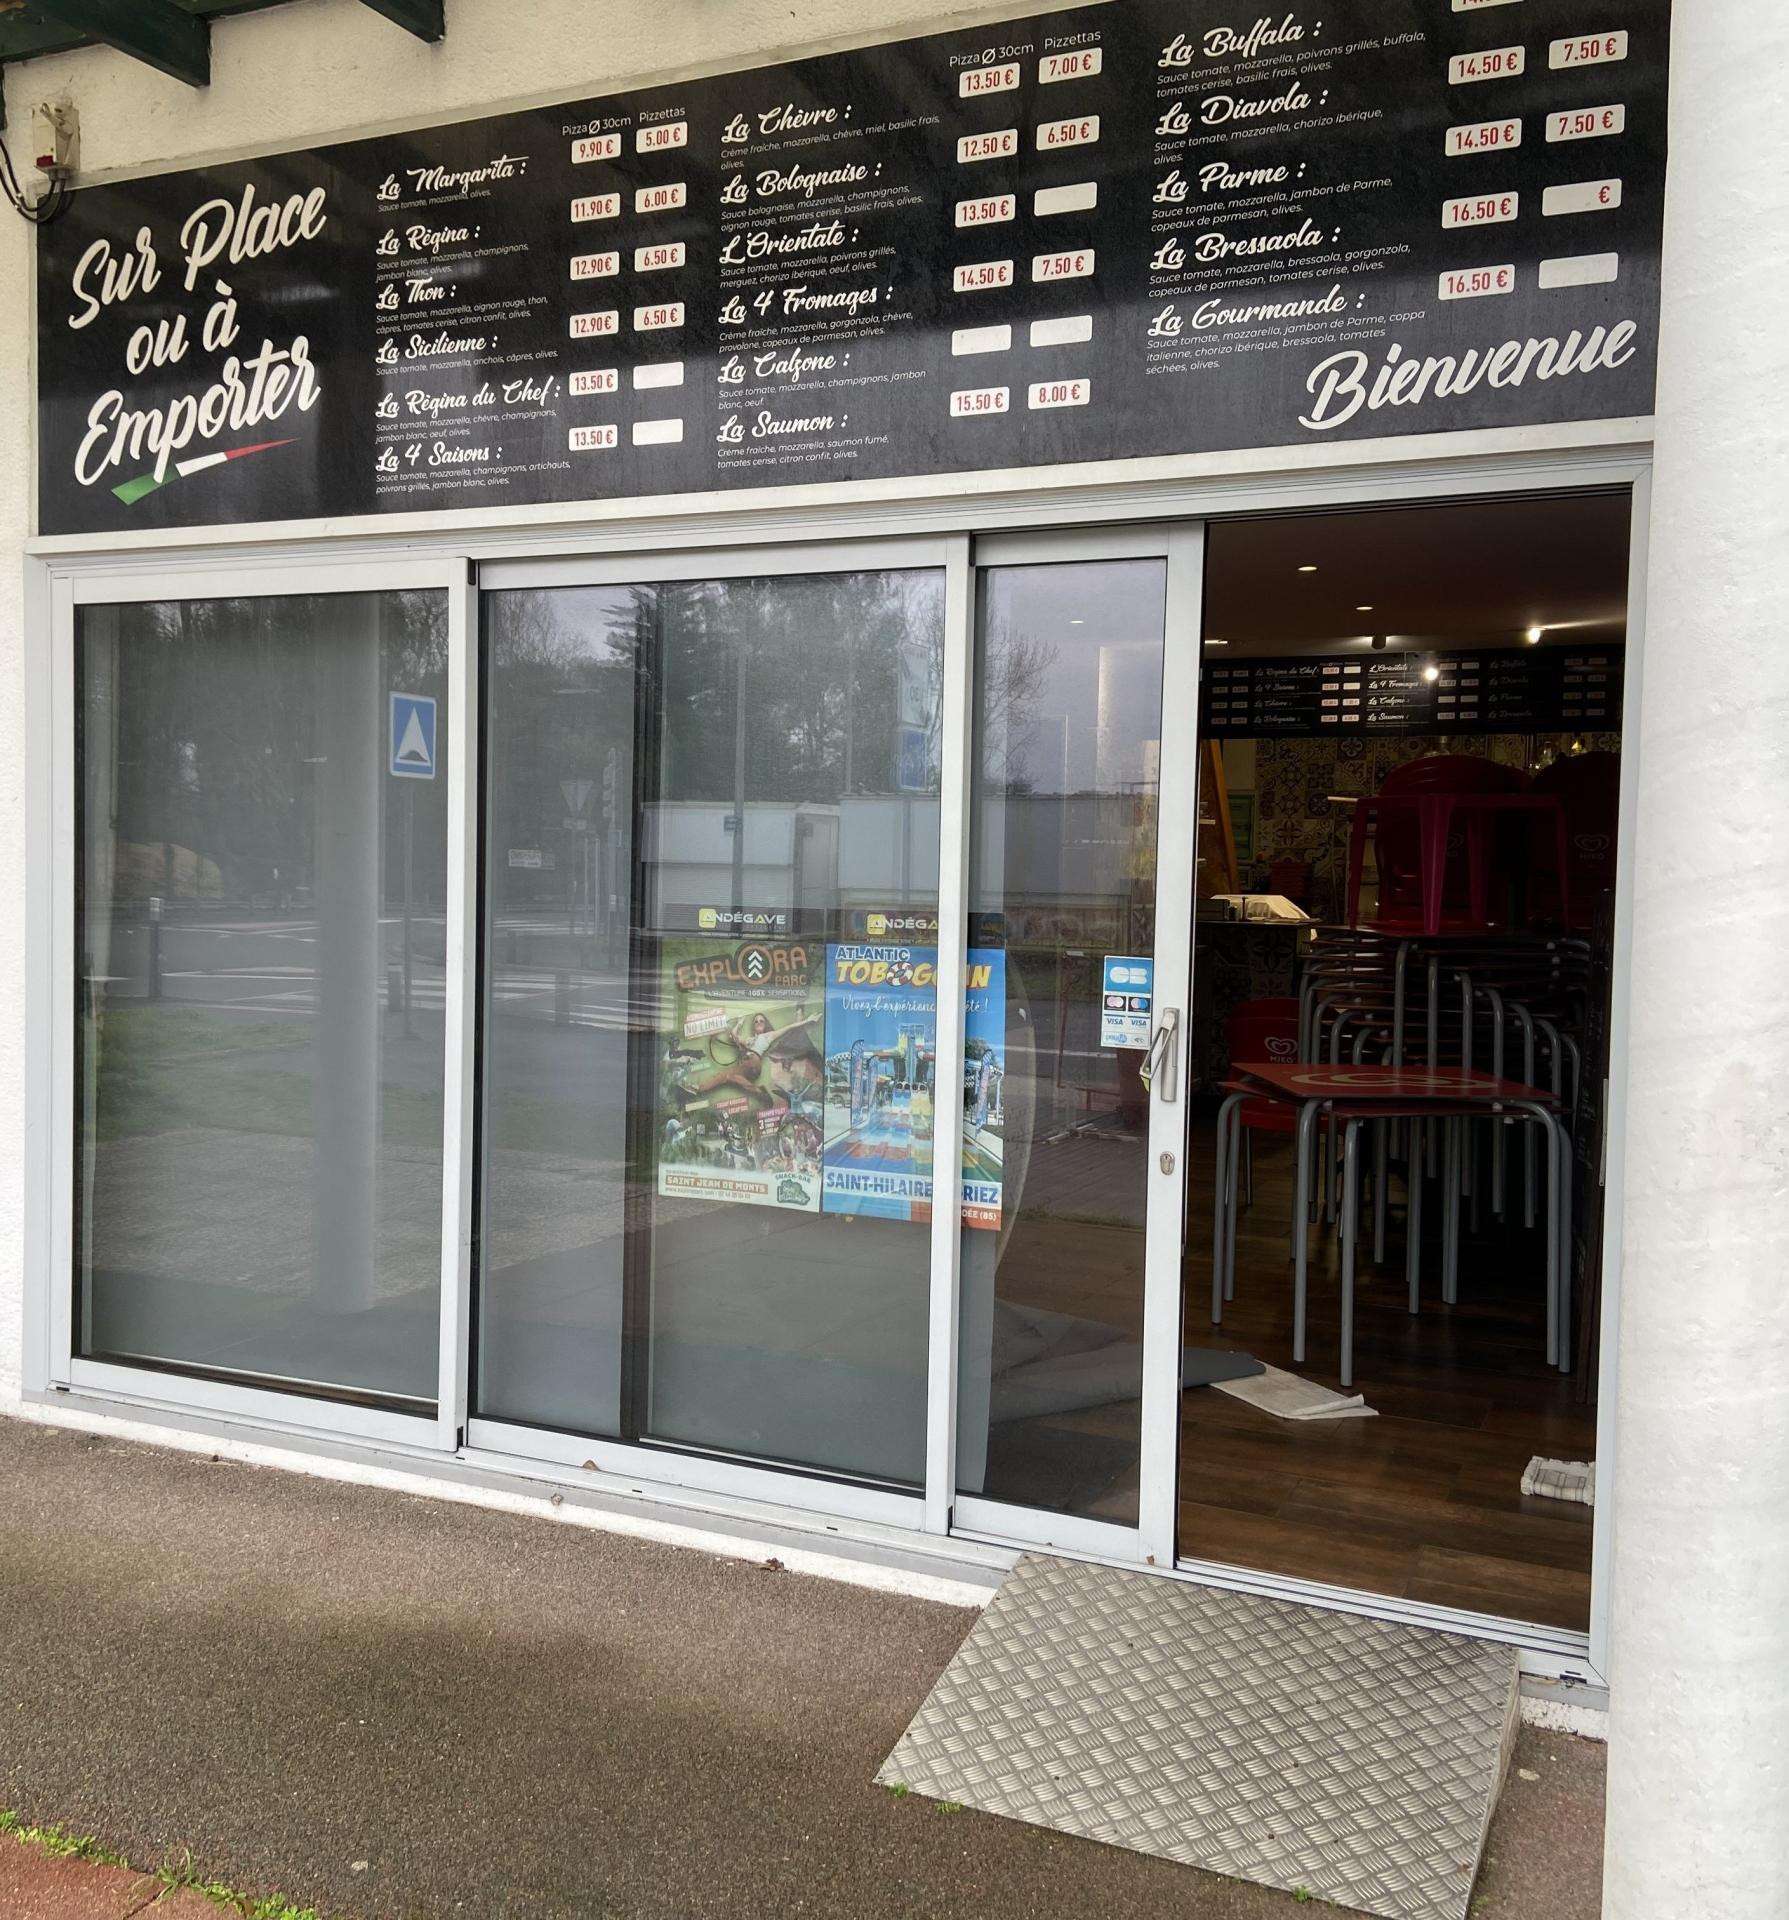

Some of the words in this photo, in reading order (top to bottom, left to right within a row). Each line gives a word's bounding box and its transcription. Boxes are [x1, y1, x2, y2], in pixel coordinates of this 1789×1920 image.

[949, 53, 980, 67] Pizza
[999, 43, 1034, 59] 30cm
[1044, 31, 1101, 50] Pizzettas
[1157, 33, 1195, 68] La
[1203, 13, 1305, 58] Buffala
[1563, 40, 1600, 62] 7.50
[1049, 56, 1078, 77] 7.00
[1458, 54, 1501, 77] 14.50
[966, 71, 1000, 91] 13.50
[1155, 101, 1192, 135] La
[1200, 81, 1311, 125] Diavola
[562, 124, 588, 136] Pizza
[602, 116, 632, 130] 30cm
[639, 107, 686, 122] Pizzettas
[721, 113, 750, 143] La
[758, 103, 839, 135] Chèvre
[1559, 113, 1595, 136] 7.50
[645, 129, 669, 147] 5.00
[1048, 124, 1076, 144] 6.50
[1455, 126, 1498, 150] 14.50
[579, 141, 602, 158] 9.90
[963, 137, 998, 157] 12.50
[377, 173, 401, 200] La
[406, 154, 530, 194] Margarita
[720, 174, 749, 204] La
[756, 163, 868, 199] Bolognaise
[1152, 169, 1189, 202] La
[1199, 162, 1290, 193] Parme
[644, 190, 668, 208] 6.00
[962, 203, 996, 223] 13.50
[1452, 200, 1496, 223] 16.50
[376, 228, 401, 256] La
[1150, 237, 1186, 270] La
[1194, 218, 1323, 262] Bressaola
[69, 226, 161, 330] Sur
[179, 183, 327, 290] Place
[644, 250, 667, 267] 6.50
[1042, 257, 1071, 276] 7.50
[960, 267, 994, 287] 14.50
[1447, 272, 1491, 295] 16.50
[375, 284, 401, 310] La
[405, 277, 446, 303] Thon
[718, 295, 747, 324] La
[753, 289, 775, 316] 4
[783, 285, 878, 315] Fromages
[643, 309, 667, 326] 6.50
[1147, 304, 1184, 337] La
[1191, 283, 1348, 330] Gourmande
[126, 314, 190, 375] ou
[202, 279, 240, 353] à
[1147, 338, 1178, 350] Sauce
[1283, 319, 1327, 336] jambon
[1330, 317, 1345, 329] de
[1389, 310, 1426, 325] coppa
[375, 338, 400, 364] La
[404, 331, 487, 360] Sicilienne
[800, 334, 810, 344] de
[1194, 343, 1233, 357] chorizo
[1339, 327, 1386, 341] tomates
[717, 355, 746, 384] La
[753, 347, 837, 382] Calzone
[1298, 319, 1637, 430] Bienvenue
[575, 374, 603, 391] 13.50
[1039, 385, 1067, 403] 8.00
[74, 336, 321, 486] Emporter
[375, 392, 400, 418] La
[472, 382, 497, 407] du
[956, 394, 991, 412] 15.50
[716, 414, 745, 443] La
[751, 410, 836, 438] Saumon
[575, 430, 603, 447] 13.50
[375, 446, 400, 472] La
[405, 442, 422, 466] 4
[428, 441, 490, 466] Saisons
[835, 945, 911, 962] ATLANTIC
[677, 943, 808, 990] EXPLORA
[775, 974, 807, 987] PARC
[1107, 1018, 1124, 1026] VISA
[1131, 1019, 1147, 1027] VISA
